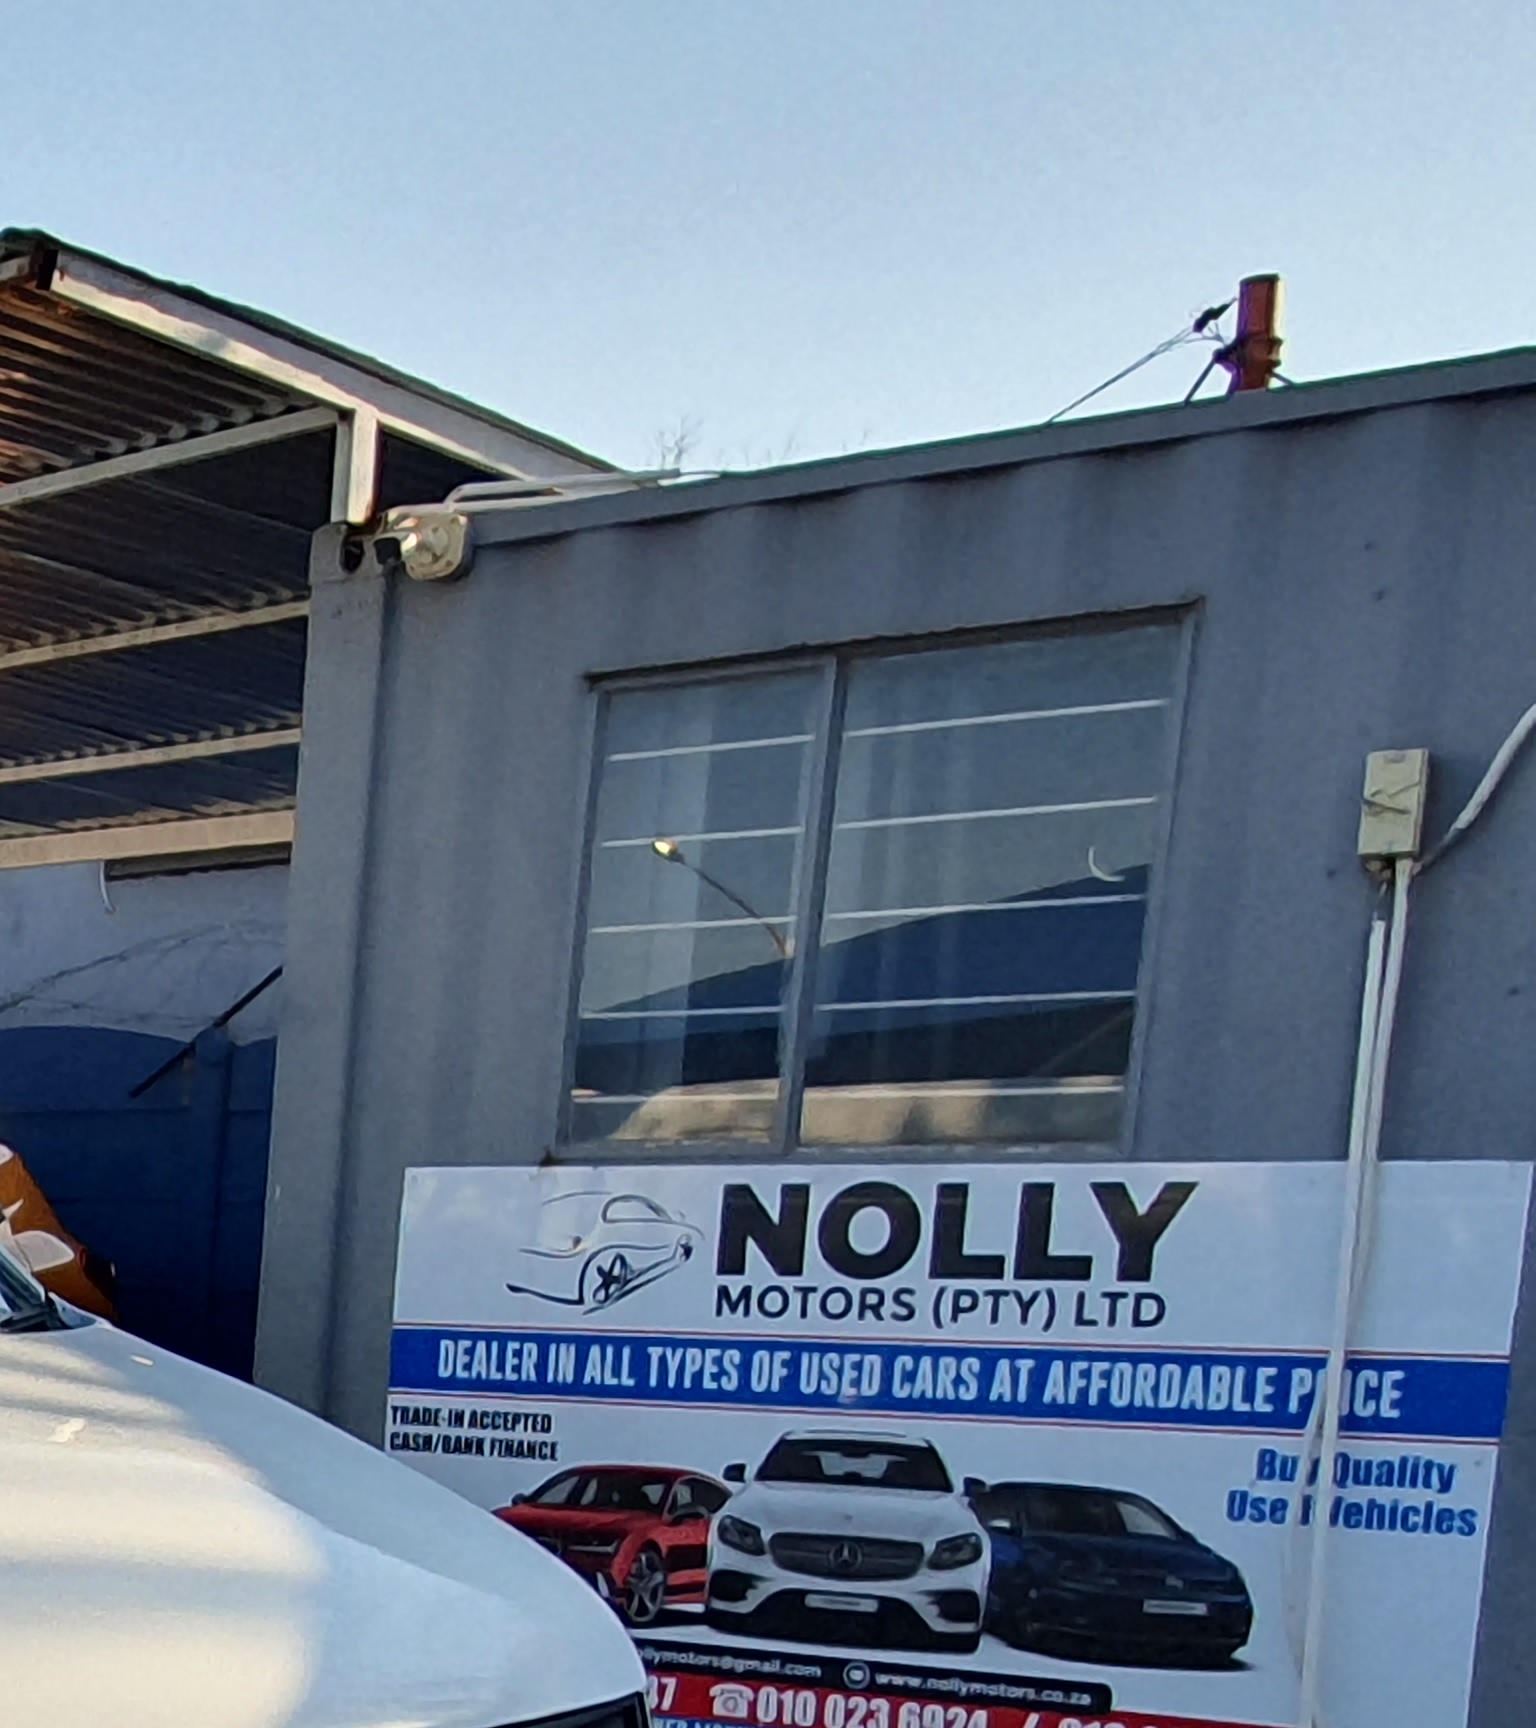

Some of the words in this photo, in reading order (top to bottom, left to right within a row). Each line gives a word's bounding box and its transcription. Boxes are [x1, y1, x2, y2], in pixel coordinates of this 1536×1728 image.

[716, 1180, 1199, 1282] NOLLY
[714, 1285, 916, 1321] MOTORS
[932, 1285, 1055, 1332] (PTY)
[1075, 1291, 1165, 1328] LTD
[438, 1338, 539, 1384] DEALER
[547, 1344, 574, 1384] IN
[583, 1345, 635, 1388] ALL
[647, 1346, 740, 1392] TYPES
[751, 1352, 789, 1394] OF
[799, 1352, 881, 1398] USED
[892, 1355, 979, 1400] CARS
[989, 1359, 1035, 1404] AT
[1043, 1361, 1278, 1413] AFFORDABLE
[1288, 1367, 1406, 1418] PICE
[390, 1405, 464, 1428] TRADE-IN
[467, 1410, 552, 1434] ACCEPTED
[488, 1437, 559, 1462] FINANCE
[1334, 1452, 1457, 1493] Quality
[757, 1686, 817, 1727] 010
